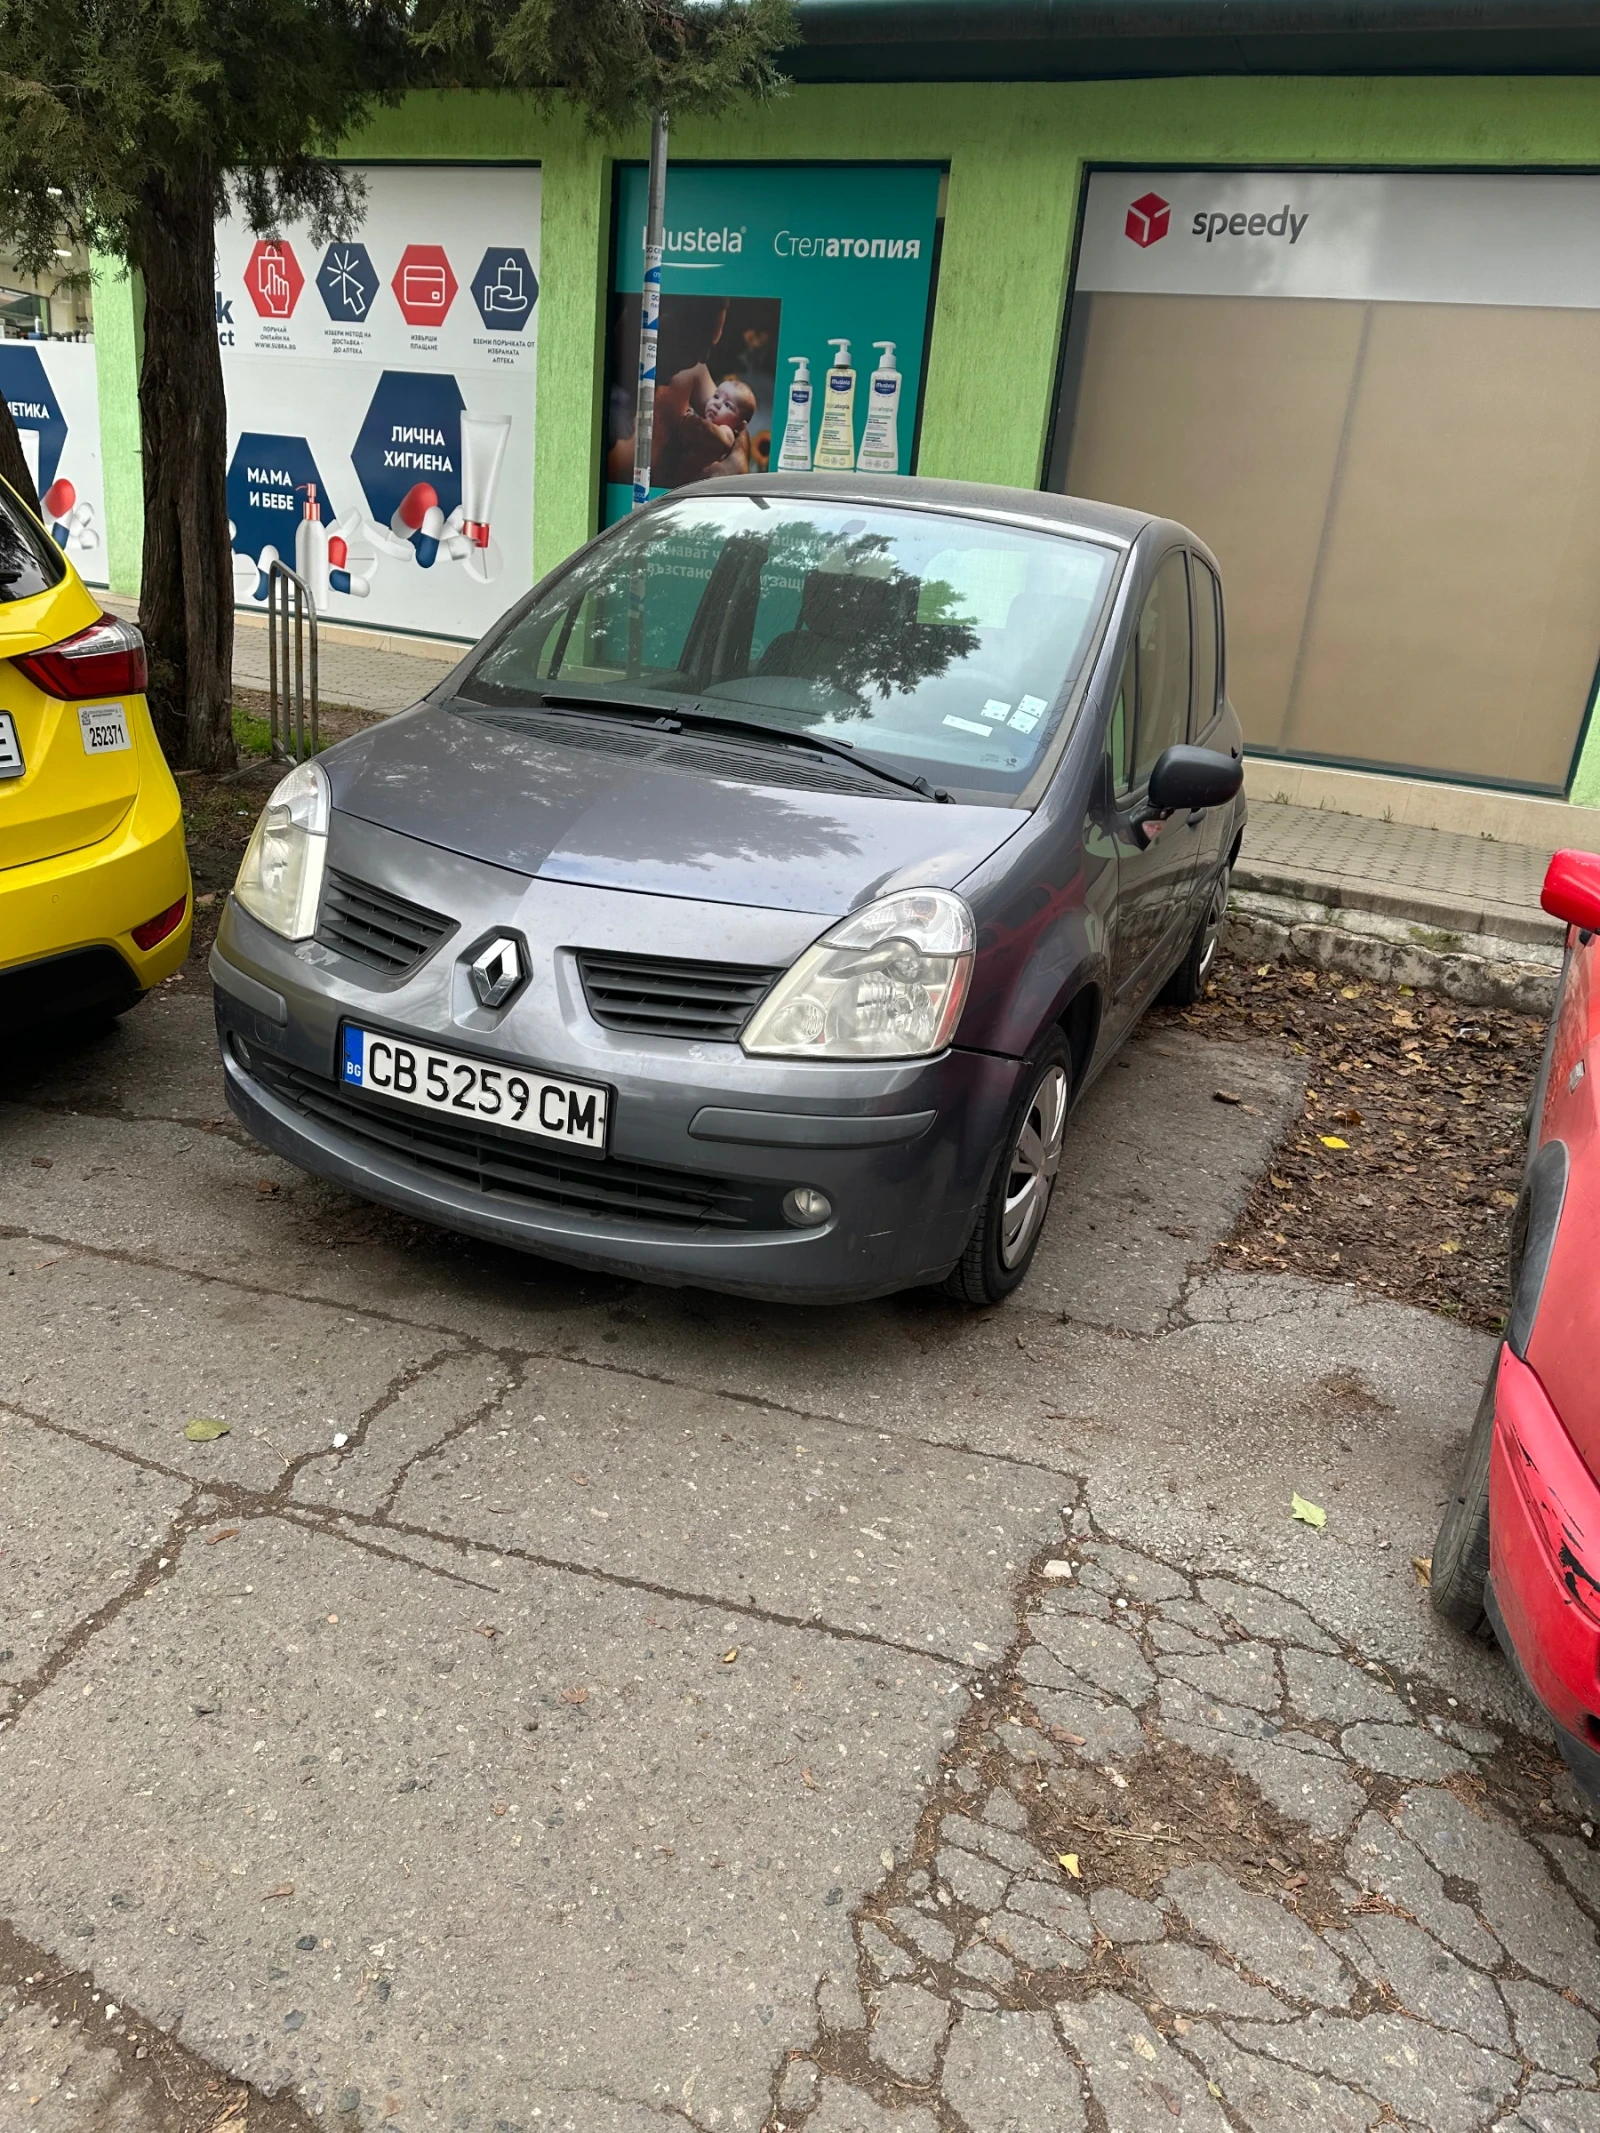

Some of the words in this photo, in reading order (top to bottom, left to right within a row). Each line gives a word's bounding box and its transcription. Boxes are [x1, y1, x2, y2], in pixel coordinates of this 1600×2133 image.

[1192, 204, 1310, 244] speedy
[774, 230, 921, 260] Стелатопия
[263, 325, 287, 333] ПОРЪЧАЙ
[260, 334, 282, 342] ОНЛАЙН
[324, 330, 345, 338] ИЗБЕРИ
[345, 331, 364, 339] МЕТОД
[254, 342, 297, 350] WWW.SUBRA.BG
[331, 338, 360, 346] ДОСТАВКА
[492, 339, 526, 347] ПОРЪЧКАТА
[342, 347, 363, 355] АПТЕКА
[410, 343, 438, 351] ПЛАЩАНЕ
[487, 348, 520, 356] ИЗБРАНАТА
[391, 425, 446, 446] ЛИЧНА
[383, 450, 454, 472] ХИГИЕНА
[247, 467, 293, 487] МАМА
[249, 491, 261, 507] И
[262, 492, 294, 511] БЕБЕ
[89, 724, 125, 748] 252371
[346, 1062, 362, 1077] BG
[368, 1042, 417, 1094] CB
[426, 1056, 530, 1121] 5259
[539, 1085, 597, 1140] CM
